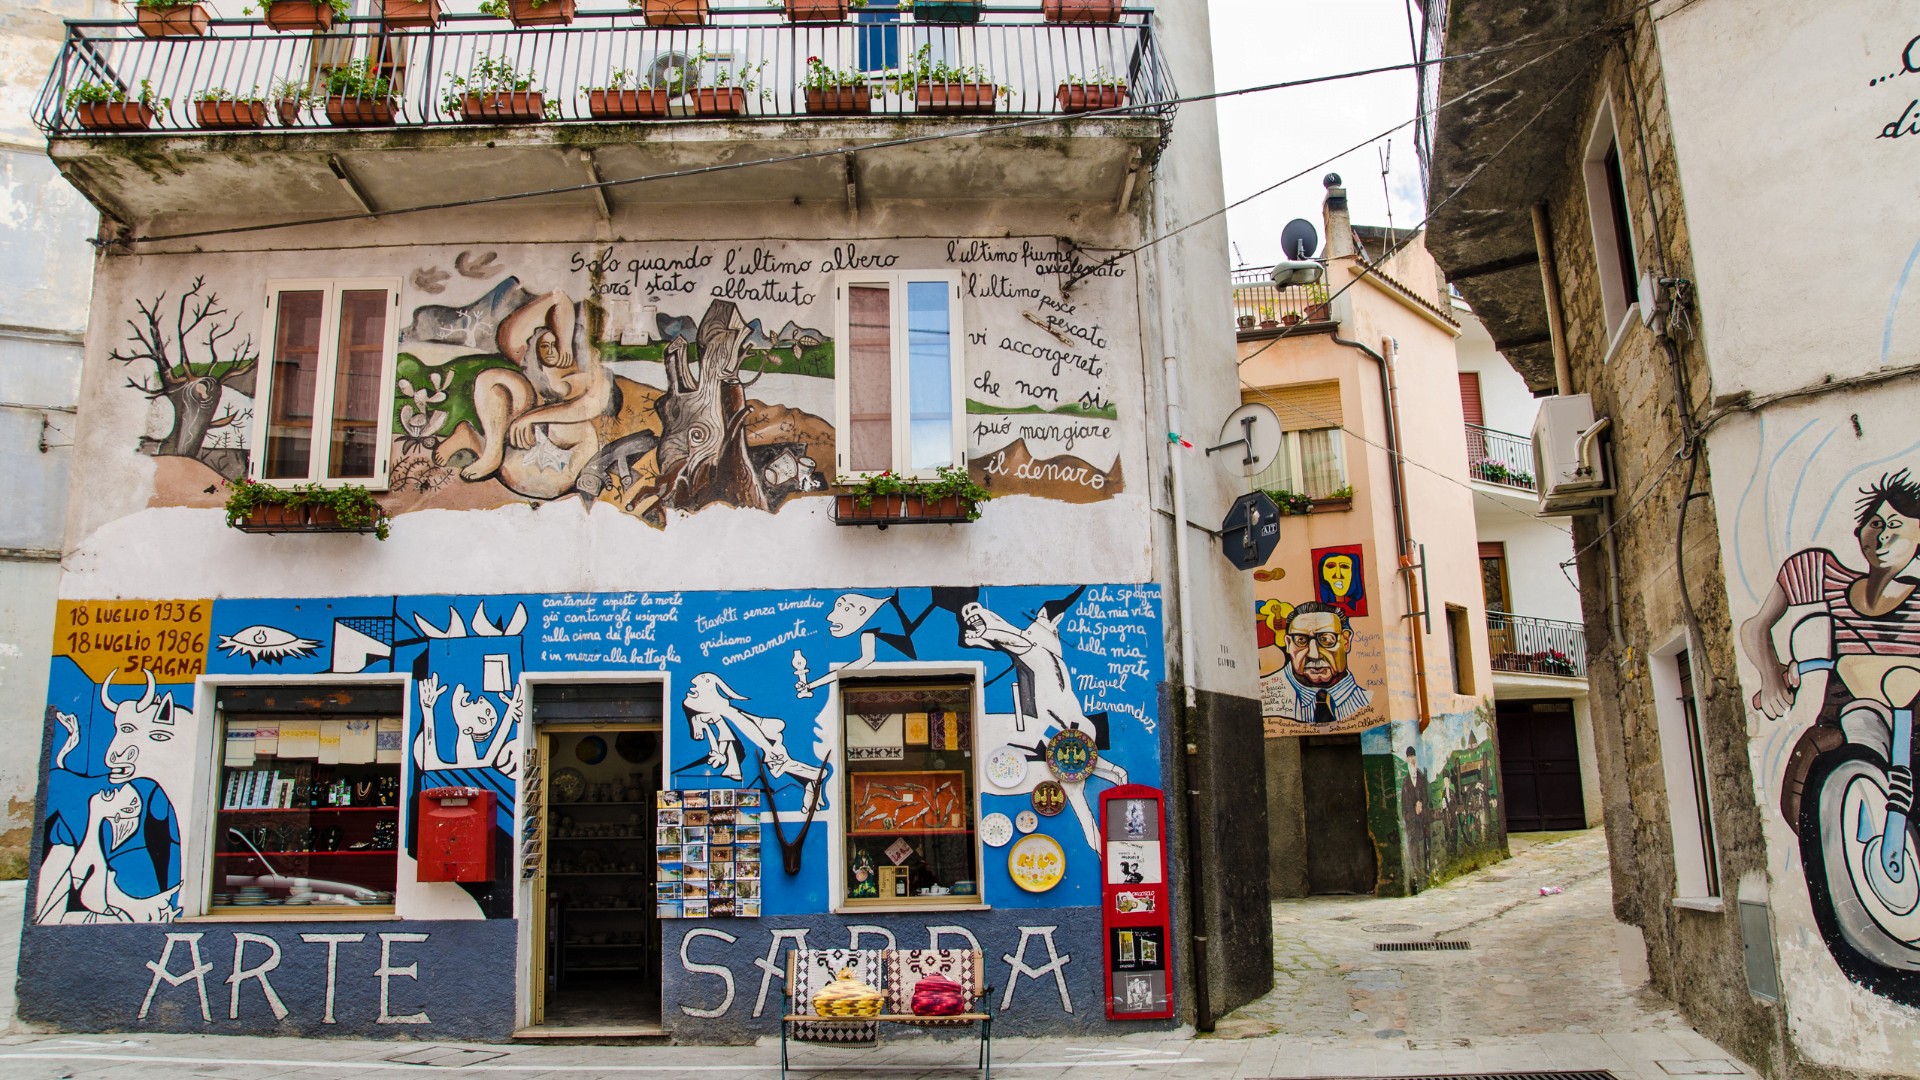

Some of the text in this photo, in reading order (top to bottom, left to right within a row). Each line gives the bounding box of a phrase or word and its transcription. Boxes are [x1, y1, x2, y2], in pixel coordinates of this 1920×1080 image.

[570, 243, 899, 287] Solo quando l'ultimo albero
[946, 240, 1072, 267] l'ultimo fiume
[1035, 256, 1126, 277] avvelenato
[645, 273, 697, 295] stato
[710, 278, 816, 306] abbattuto
[967, 273, 1076, 316] l'ultimo pesce
[1046, 314, 1107, 349] pescato
[968, 328, 1103, 379] vi accorgerete
[974, 370, 1109, 411] che non si
[1020, 421, 1112, 451] mangiare
[983, 451, 1105, 489] il denaro
[542, 592, 683, 611] cantando aspetto la morte
[1076, 602, 1156, 619] della mia vita
[1087, 586, 1162, 608] Ahi Spagna
[70, 602, 202, 626] 18 LUGLIO 1936
[564, 607, 614, 623] cantano
[614, 608, 632, 629] gli
[635, 607, 679, 629] usignoli
[694, 594, 824, 633] travolti senza rimedio
[67, 631, 91, 654] 18
[156, 629, 204, 654] 1986
[542, 625, 656, 646] sulla cima dei fucili
[700, 631, 751, 657] gridiamo
[1067, 620, 1147, 642] Ahi Spagna
[549, 649, 562, 661] in
[602, 647, 628, 663] alla
[629, 644, 682, 671] battaglia
[1077, 637, 1147, 658] della mia
[124, 655, 202, 676] SPAGNA
[1107, 659, 1150, 681] morte
[1083, 694, 1157, 735] Hernandez
[136, 931, 432, 1024] ARTE
[678, 924, 1075, 1020] SAA
